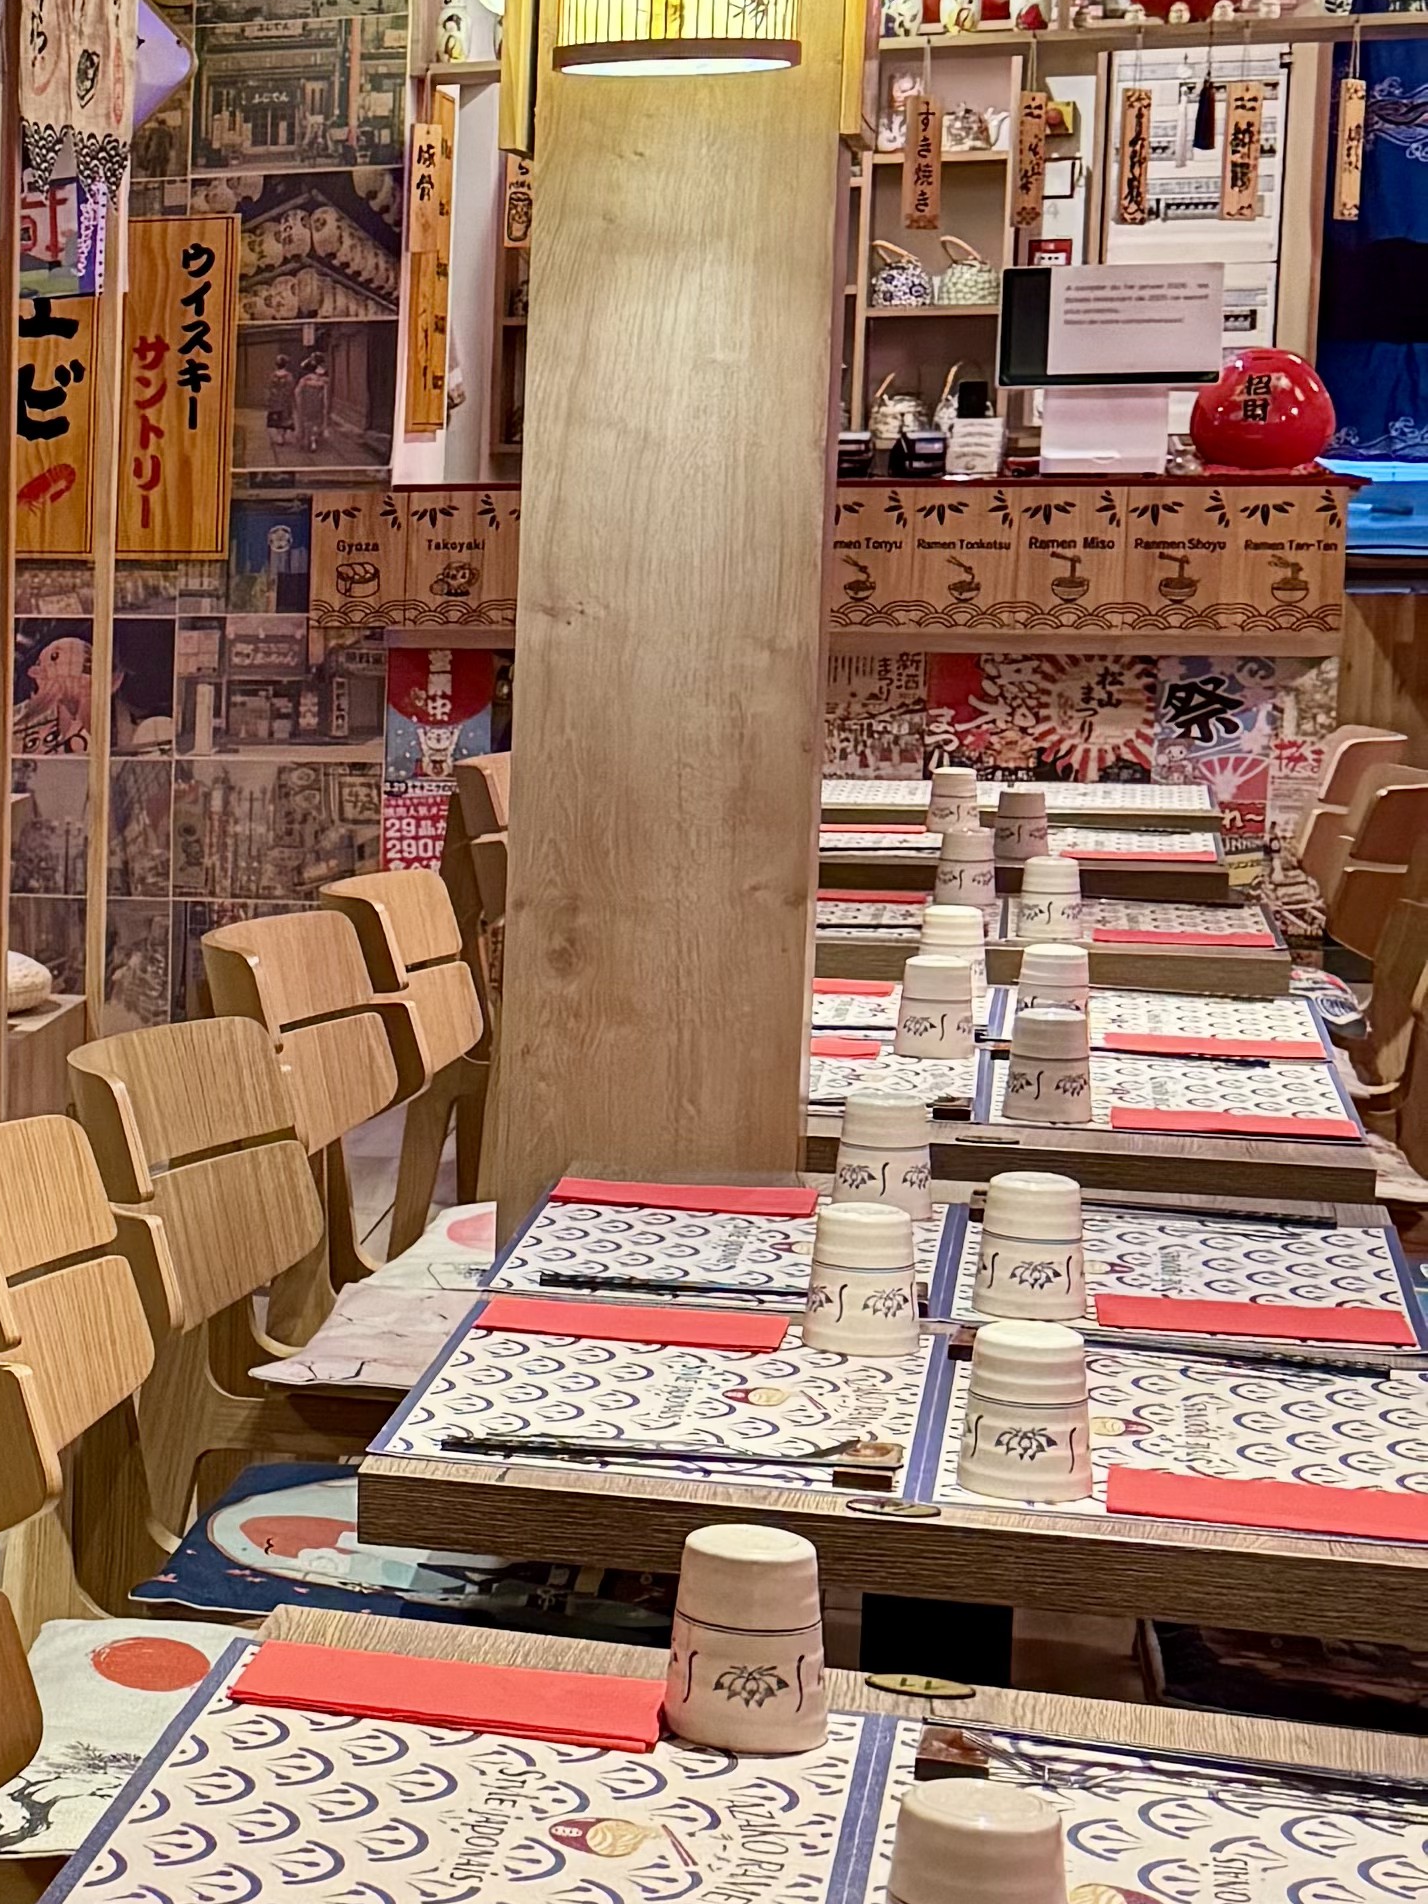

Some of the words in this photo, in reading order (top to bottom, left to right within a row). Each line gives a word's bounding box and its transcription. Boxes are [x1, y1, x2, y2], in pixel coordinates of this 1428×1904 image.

[178, 242, 217, 431] ウイスキー
[132, 335, 170, 530] サントリー
[336, 539, 379, 554] Gyoza
[426, 538, 486, 553] Takoyaki
[833, 539, 861, 550] men
[1029, 536, 1077, 549] Ramen
[1083, 536, 1115, 549] Miso
[1162, 676, 1243, 742] 祭
